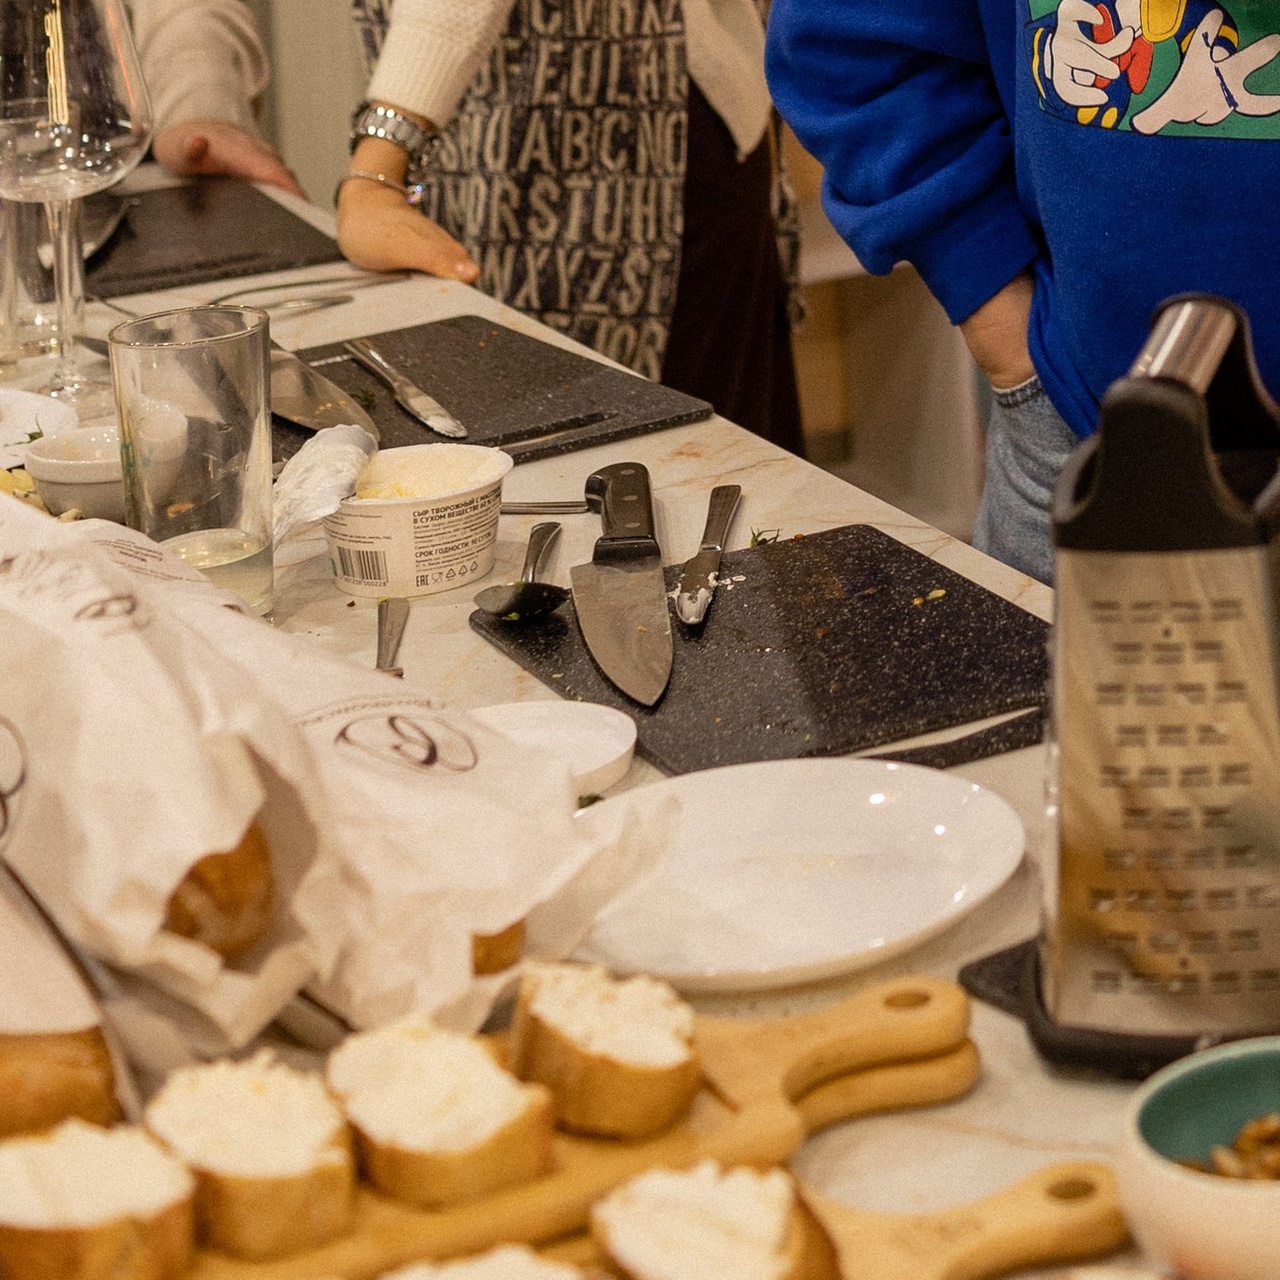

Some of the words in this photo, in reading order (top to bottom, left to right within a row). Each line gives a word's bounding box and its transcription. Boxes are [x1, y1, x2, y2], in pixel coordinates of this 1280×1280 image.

[412, 509, 429, 517] СЫР
[420, 513, 446, 523] СУХОМ
[415, 550, 434, 558] СРОК
